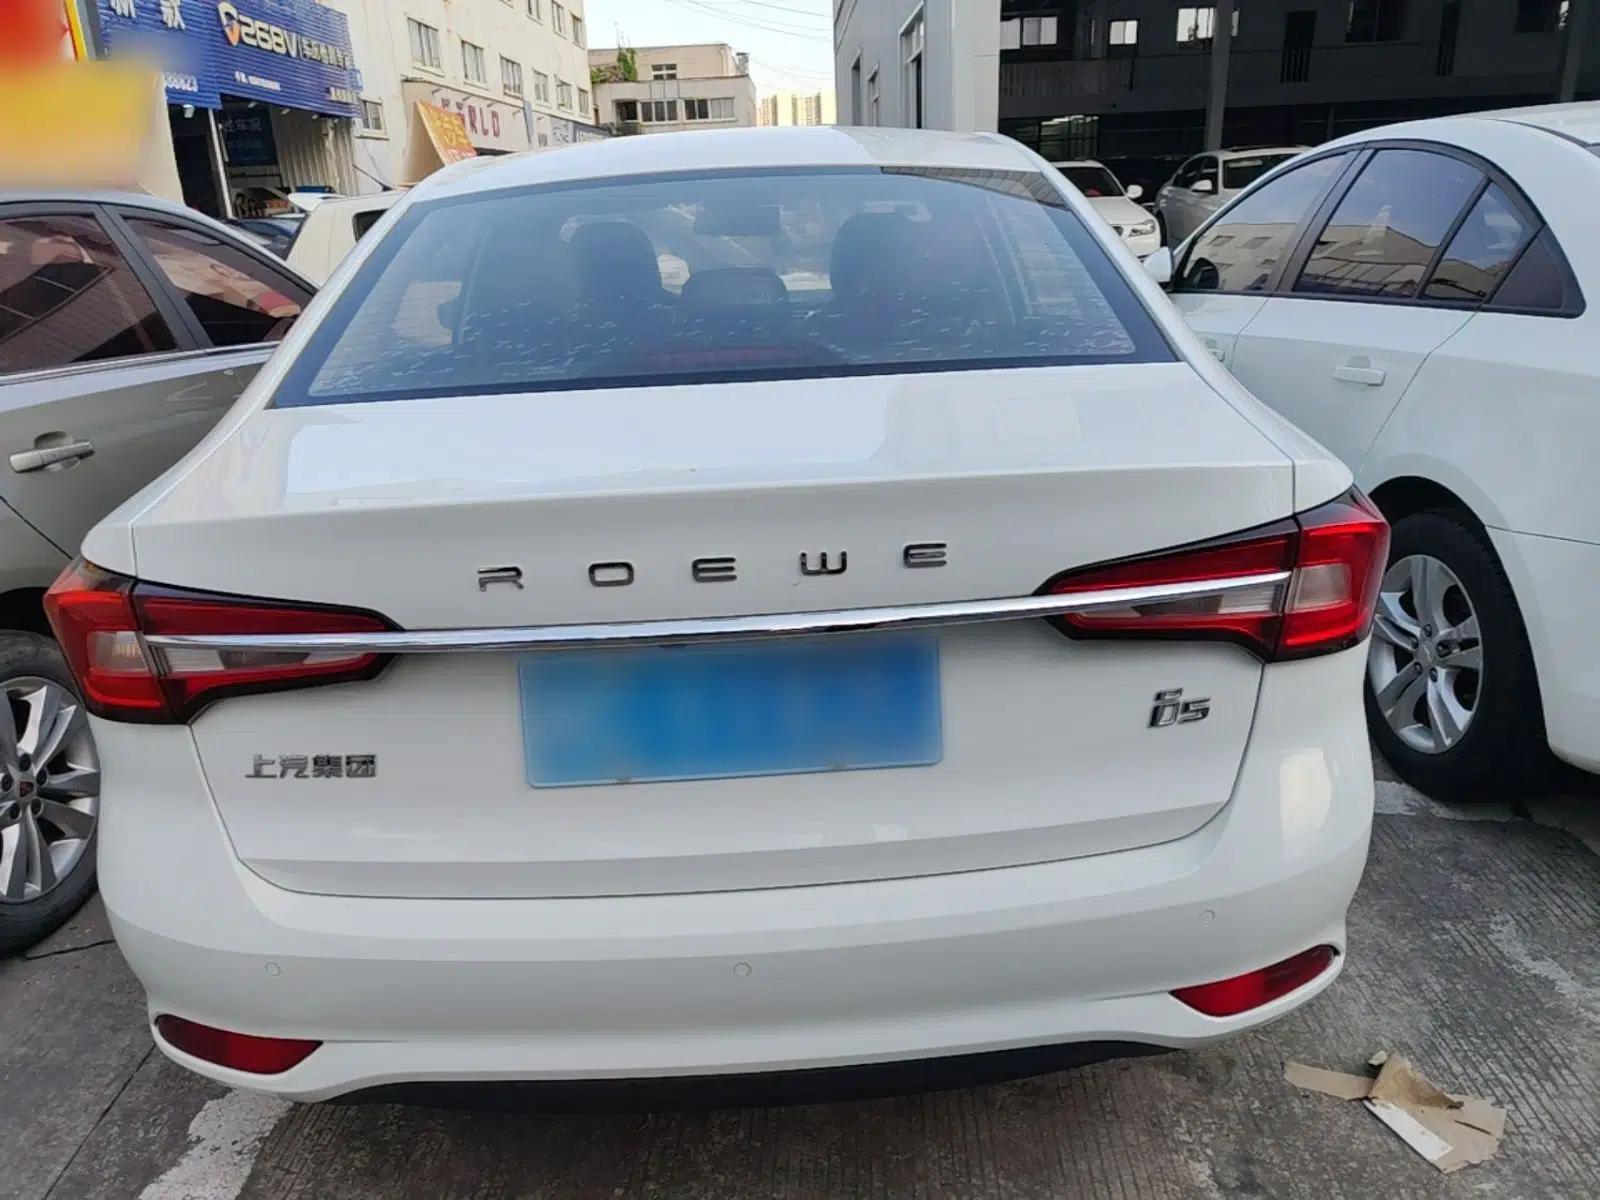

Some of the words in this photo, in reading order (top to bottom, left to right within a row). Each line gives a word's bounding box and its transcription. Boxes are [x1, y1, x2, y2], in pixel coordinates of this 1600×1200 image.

[477, 542, 947, 593] ROEWE
[244, 753, 377, 779] 上汽集团
